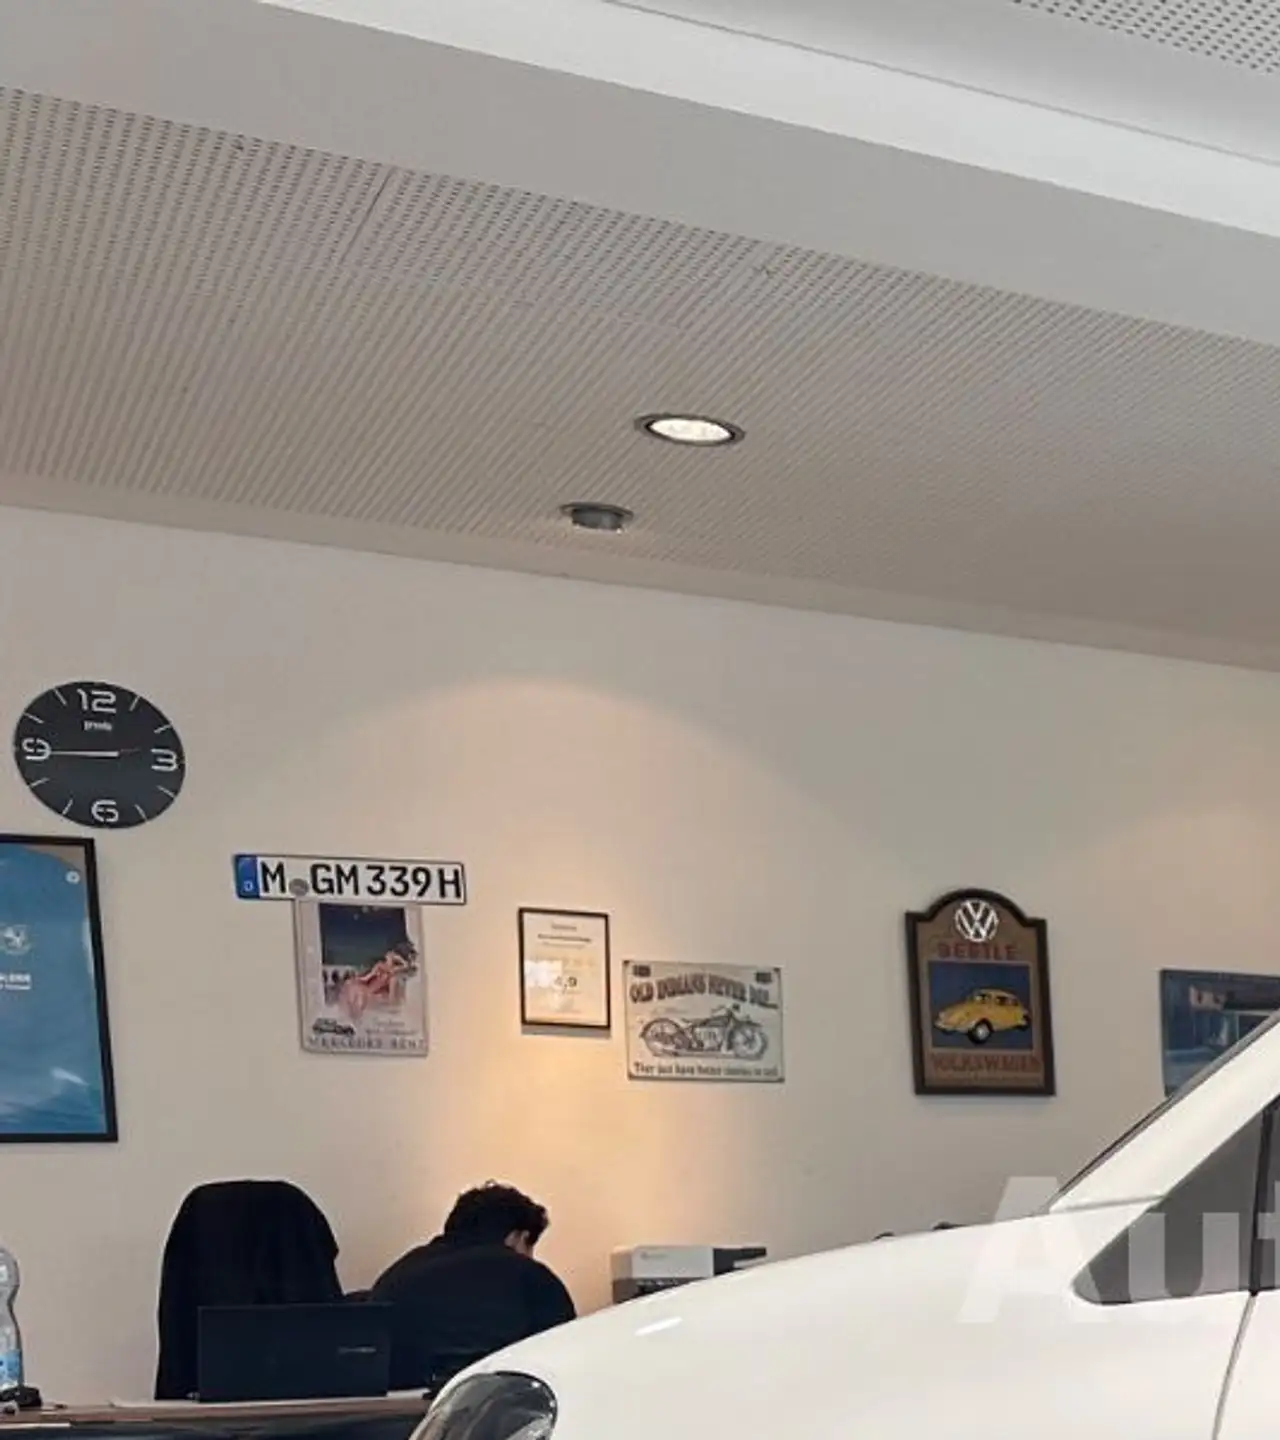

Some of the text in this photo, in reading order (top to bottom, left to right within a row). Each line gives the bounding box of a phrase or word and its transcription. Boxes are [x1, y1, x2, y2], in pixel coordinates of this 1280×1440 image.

[77, 689, 117, 713] 12
[22, 738, 51, 761] 9
[151, 748, 179, 772] 3
[91, 799, 119, 823] 6
[260, 860, 287, 894] M
